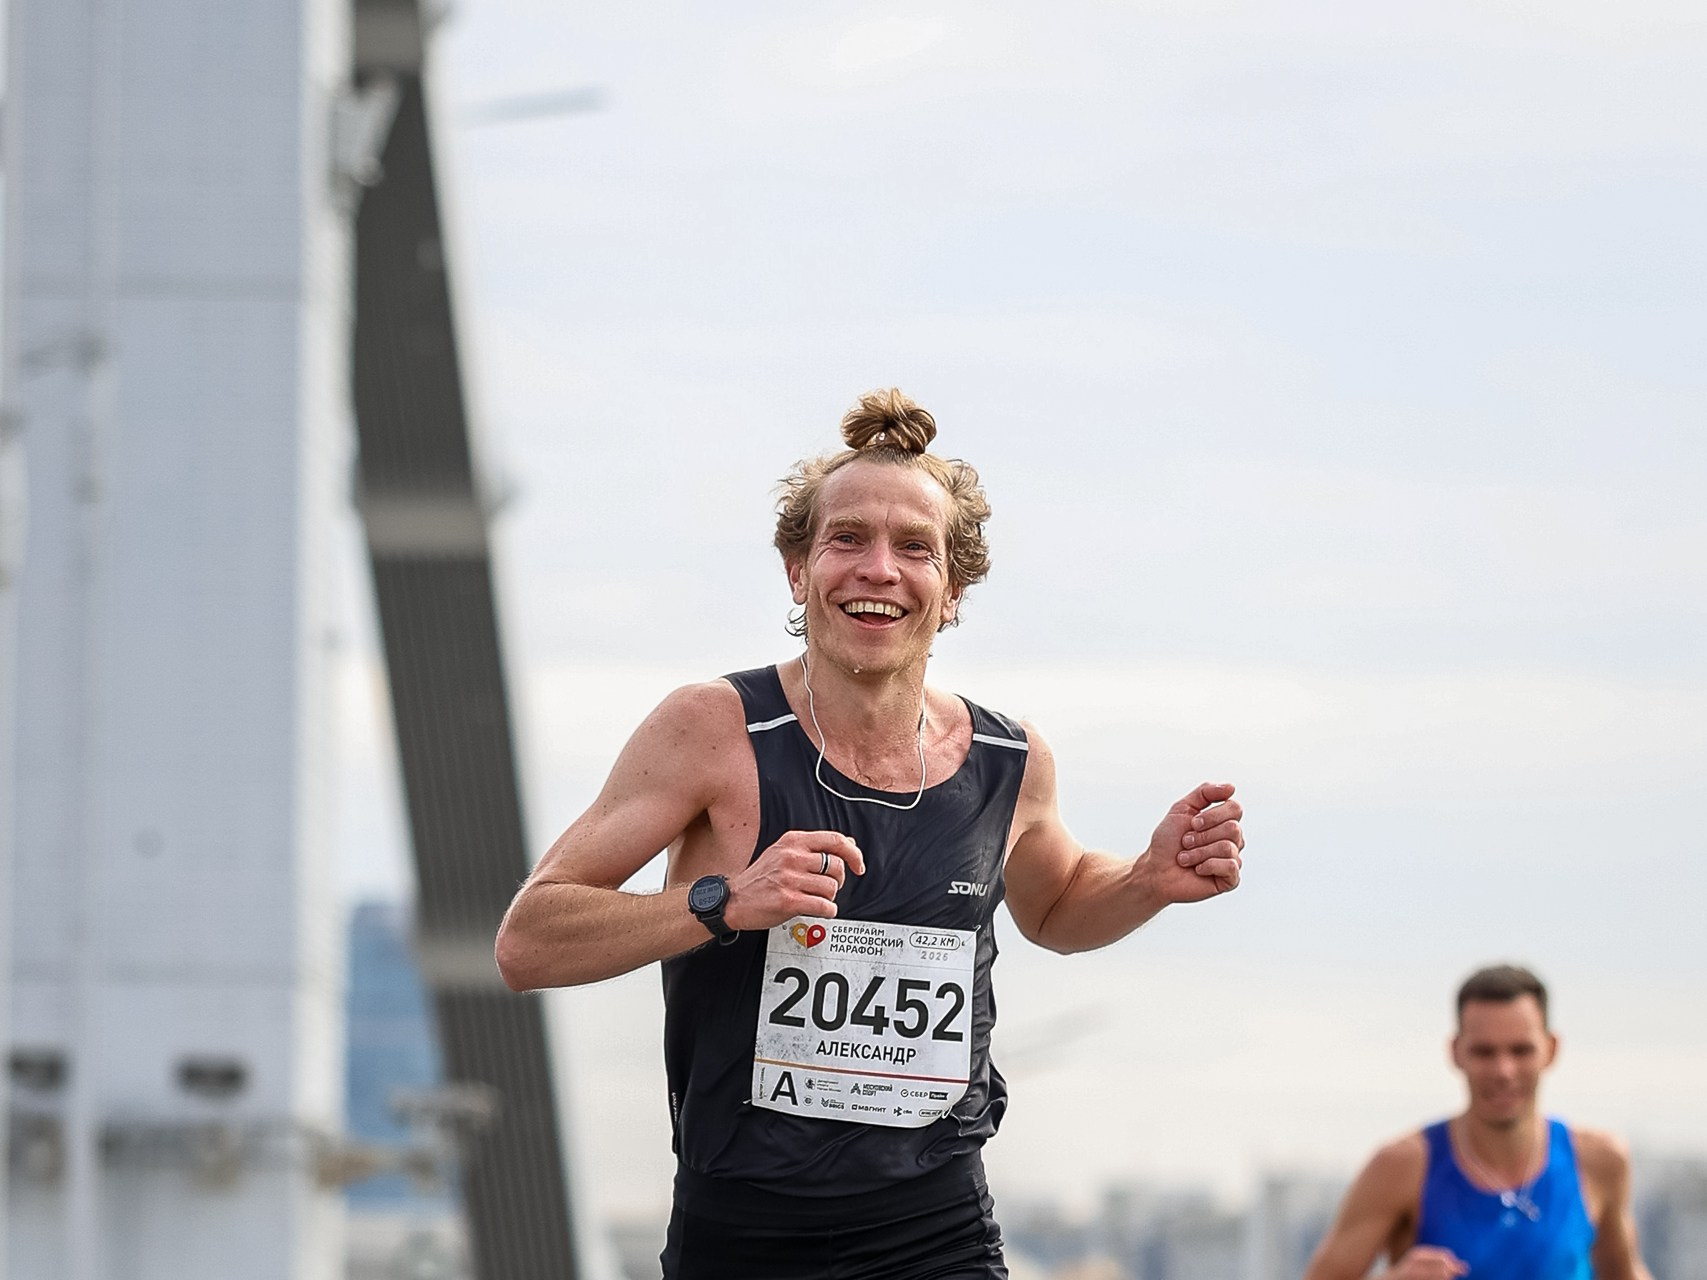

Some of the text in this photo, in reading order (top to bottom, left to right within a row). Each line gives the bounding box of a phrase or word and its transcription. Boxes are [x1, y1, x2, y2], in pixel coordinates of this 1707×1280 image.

[947, 881, 988, 897] SONU
[832, 925, 885, 936] СБЕРПРАЙМ
[831, 934, 904, 948] МОСКОВСКИЙ
[915, 936, 955, 947] 42,2 КМ
[829, 944, 883, 956] МАРАФОН
[768, 967, 965, 1042] 20452
[816, 1040, 917, 1065] АЛЕКСАНДР
